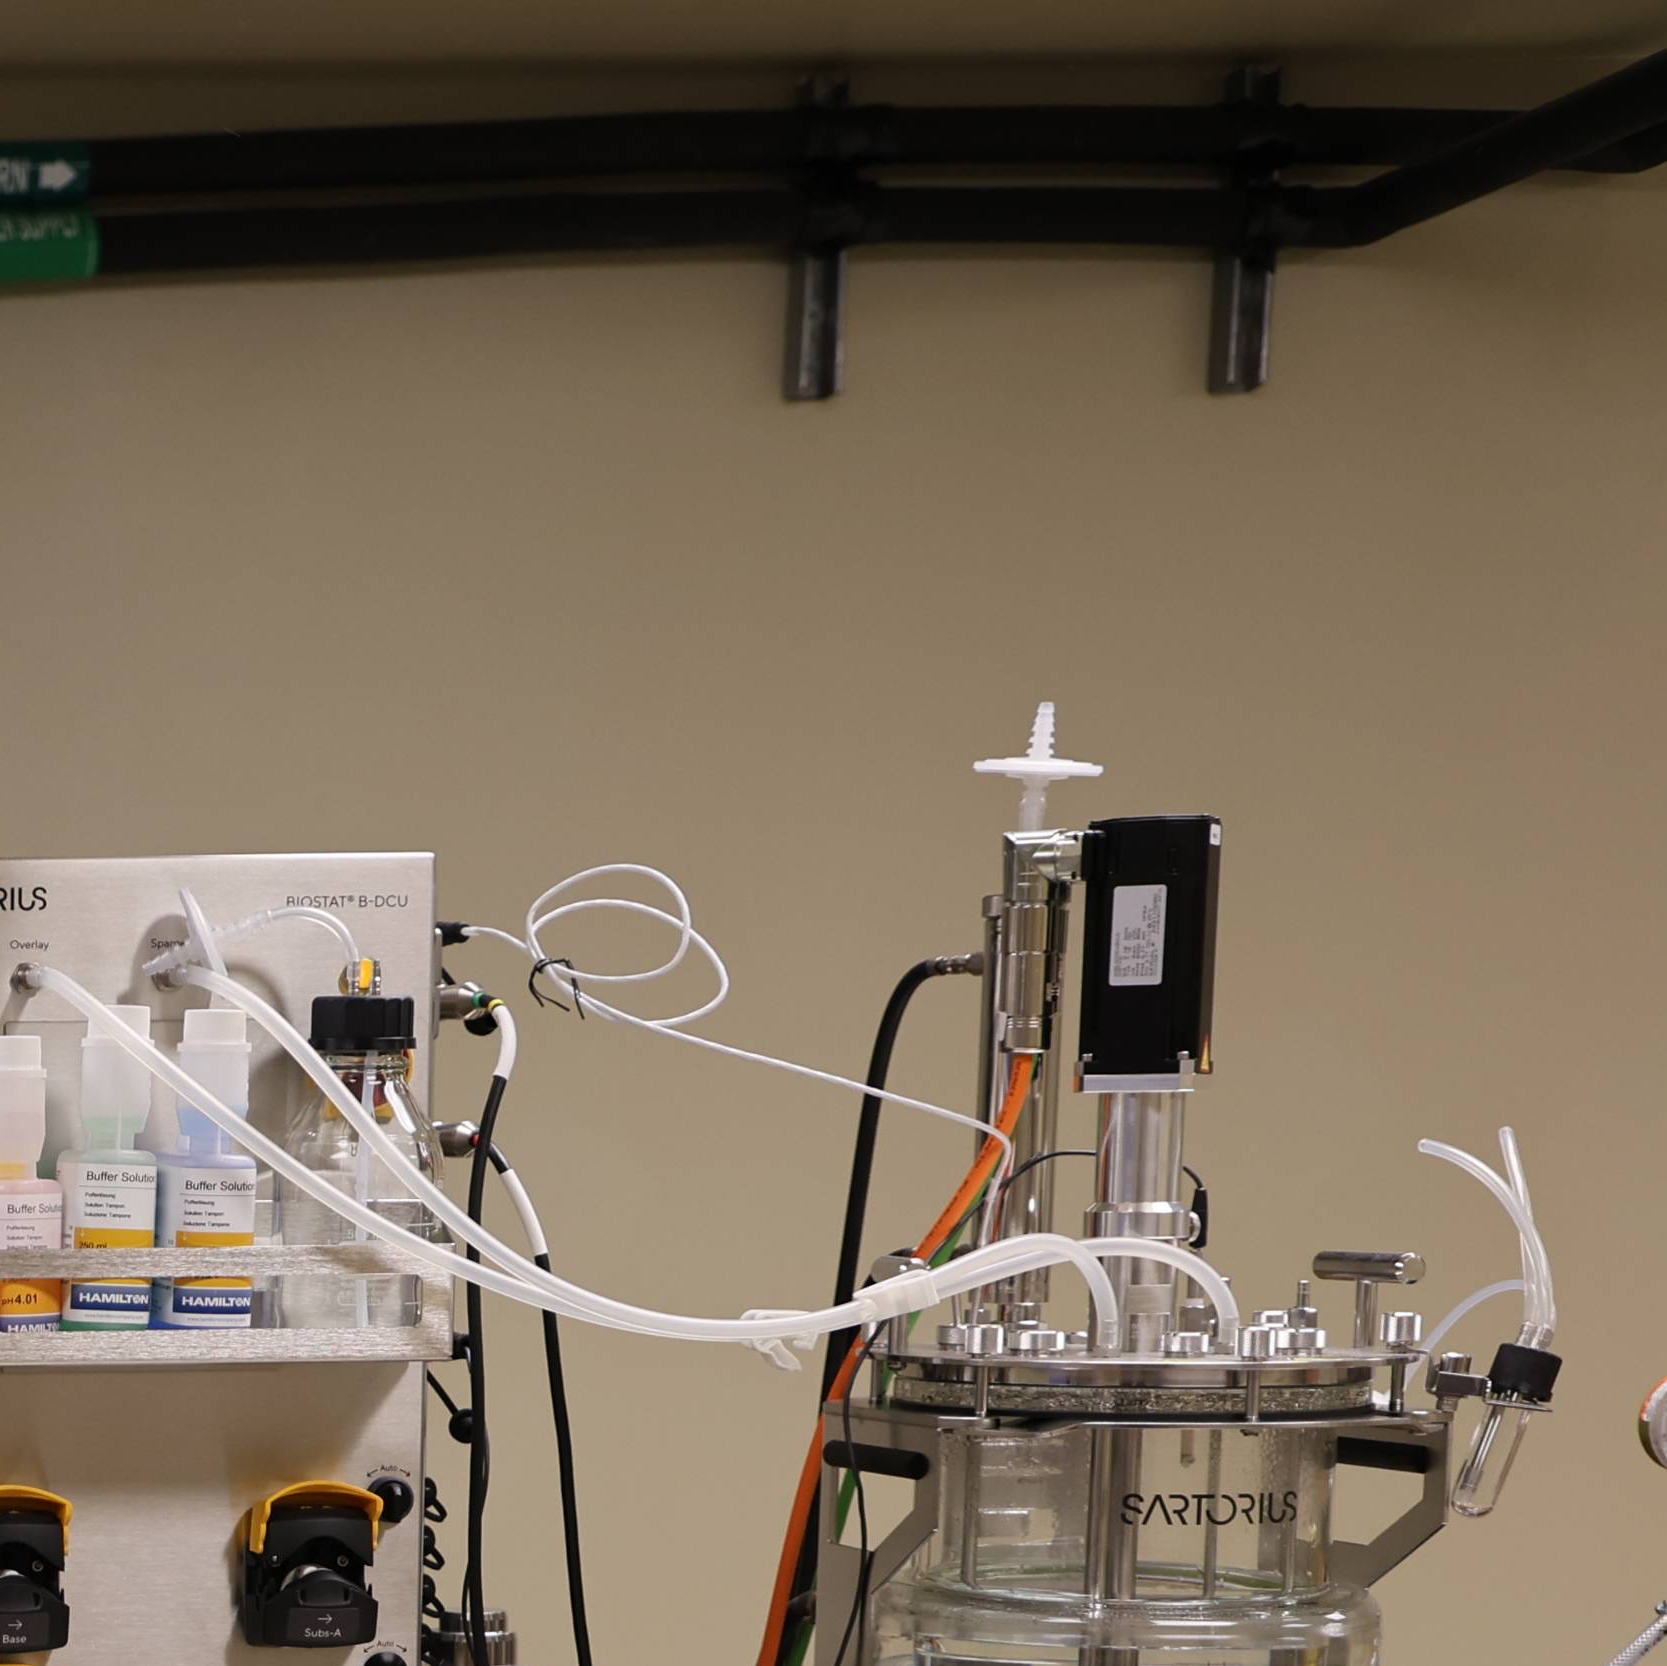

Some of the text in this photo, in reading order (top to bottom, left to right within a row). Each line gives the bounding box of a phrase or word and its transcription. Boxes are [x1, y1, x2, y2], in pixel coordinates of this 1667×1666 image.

[358, 894, 409, 908] B-DCU
[10, 939, 50, 951] Overlay
[87, 1170, 119, 1182] Buffer
[185, 1179, 217, 1191] Buffer
[7, 1203, 36, 1214] Buffer
[79, 1292, 149, 1305] HAMILTON
[182, 1296, 250, 1307] HAMILTON
[380, 1464, 398, 1472] Auto
[1120, 1490, 1298, 1526] SARTORIUS
[304, 1627, 342, 1639] Subs-A
[2, 1634, 27, 1645] Base
[376, 1640, 395, 1648] Auto
